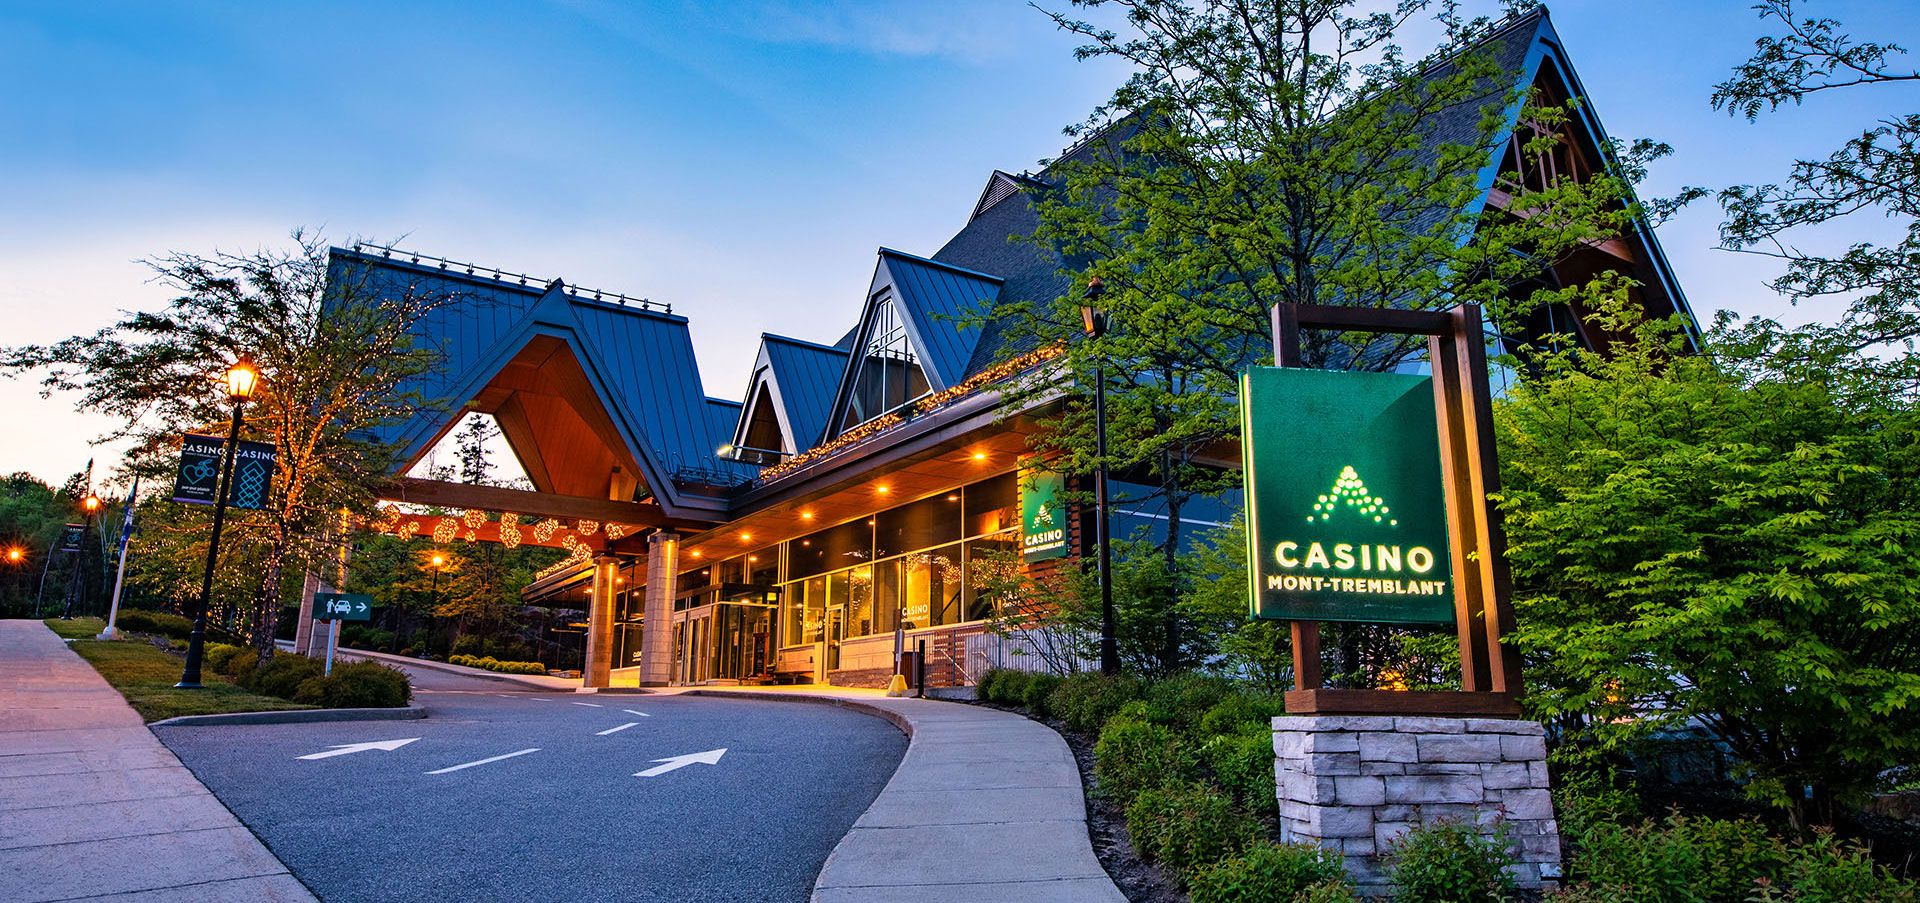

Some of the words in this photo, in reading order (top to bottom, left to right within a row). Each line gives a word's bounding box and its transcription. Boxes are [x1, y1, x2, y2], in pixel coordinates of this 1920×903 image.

[1025, 529, 1062, 546] CASINO
[1275, 541, 1434, 573] CASINO
[1268, 575, 1446, 595] MONT-TREMBLANT
[902, 604, 928, 617] CASINO
